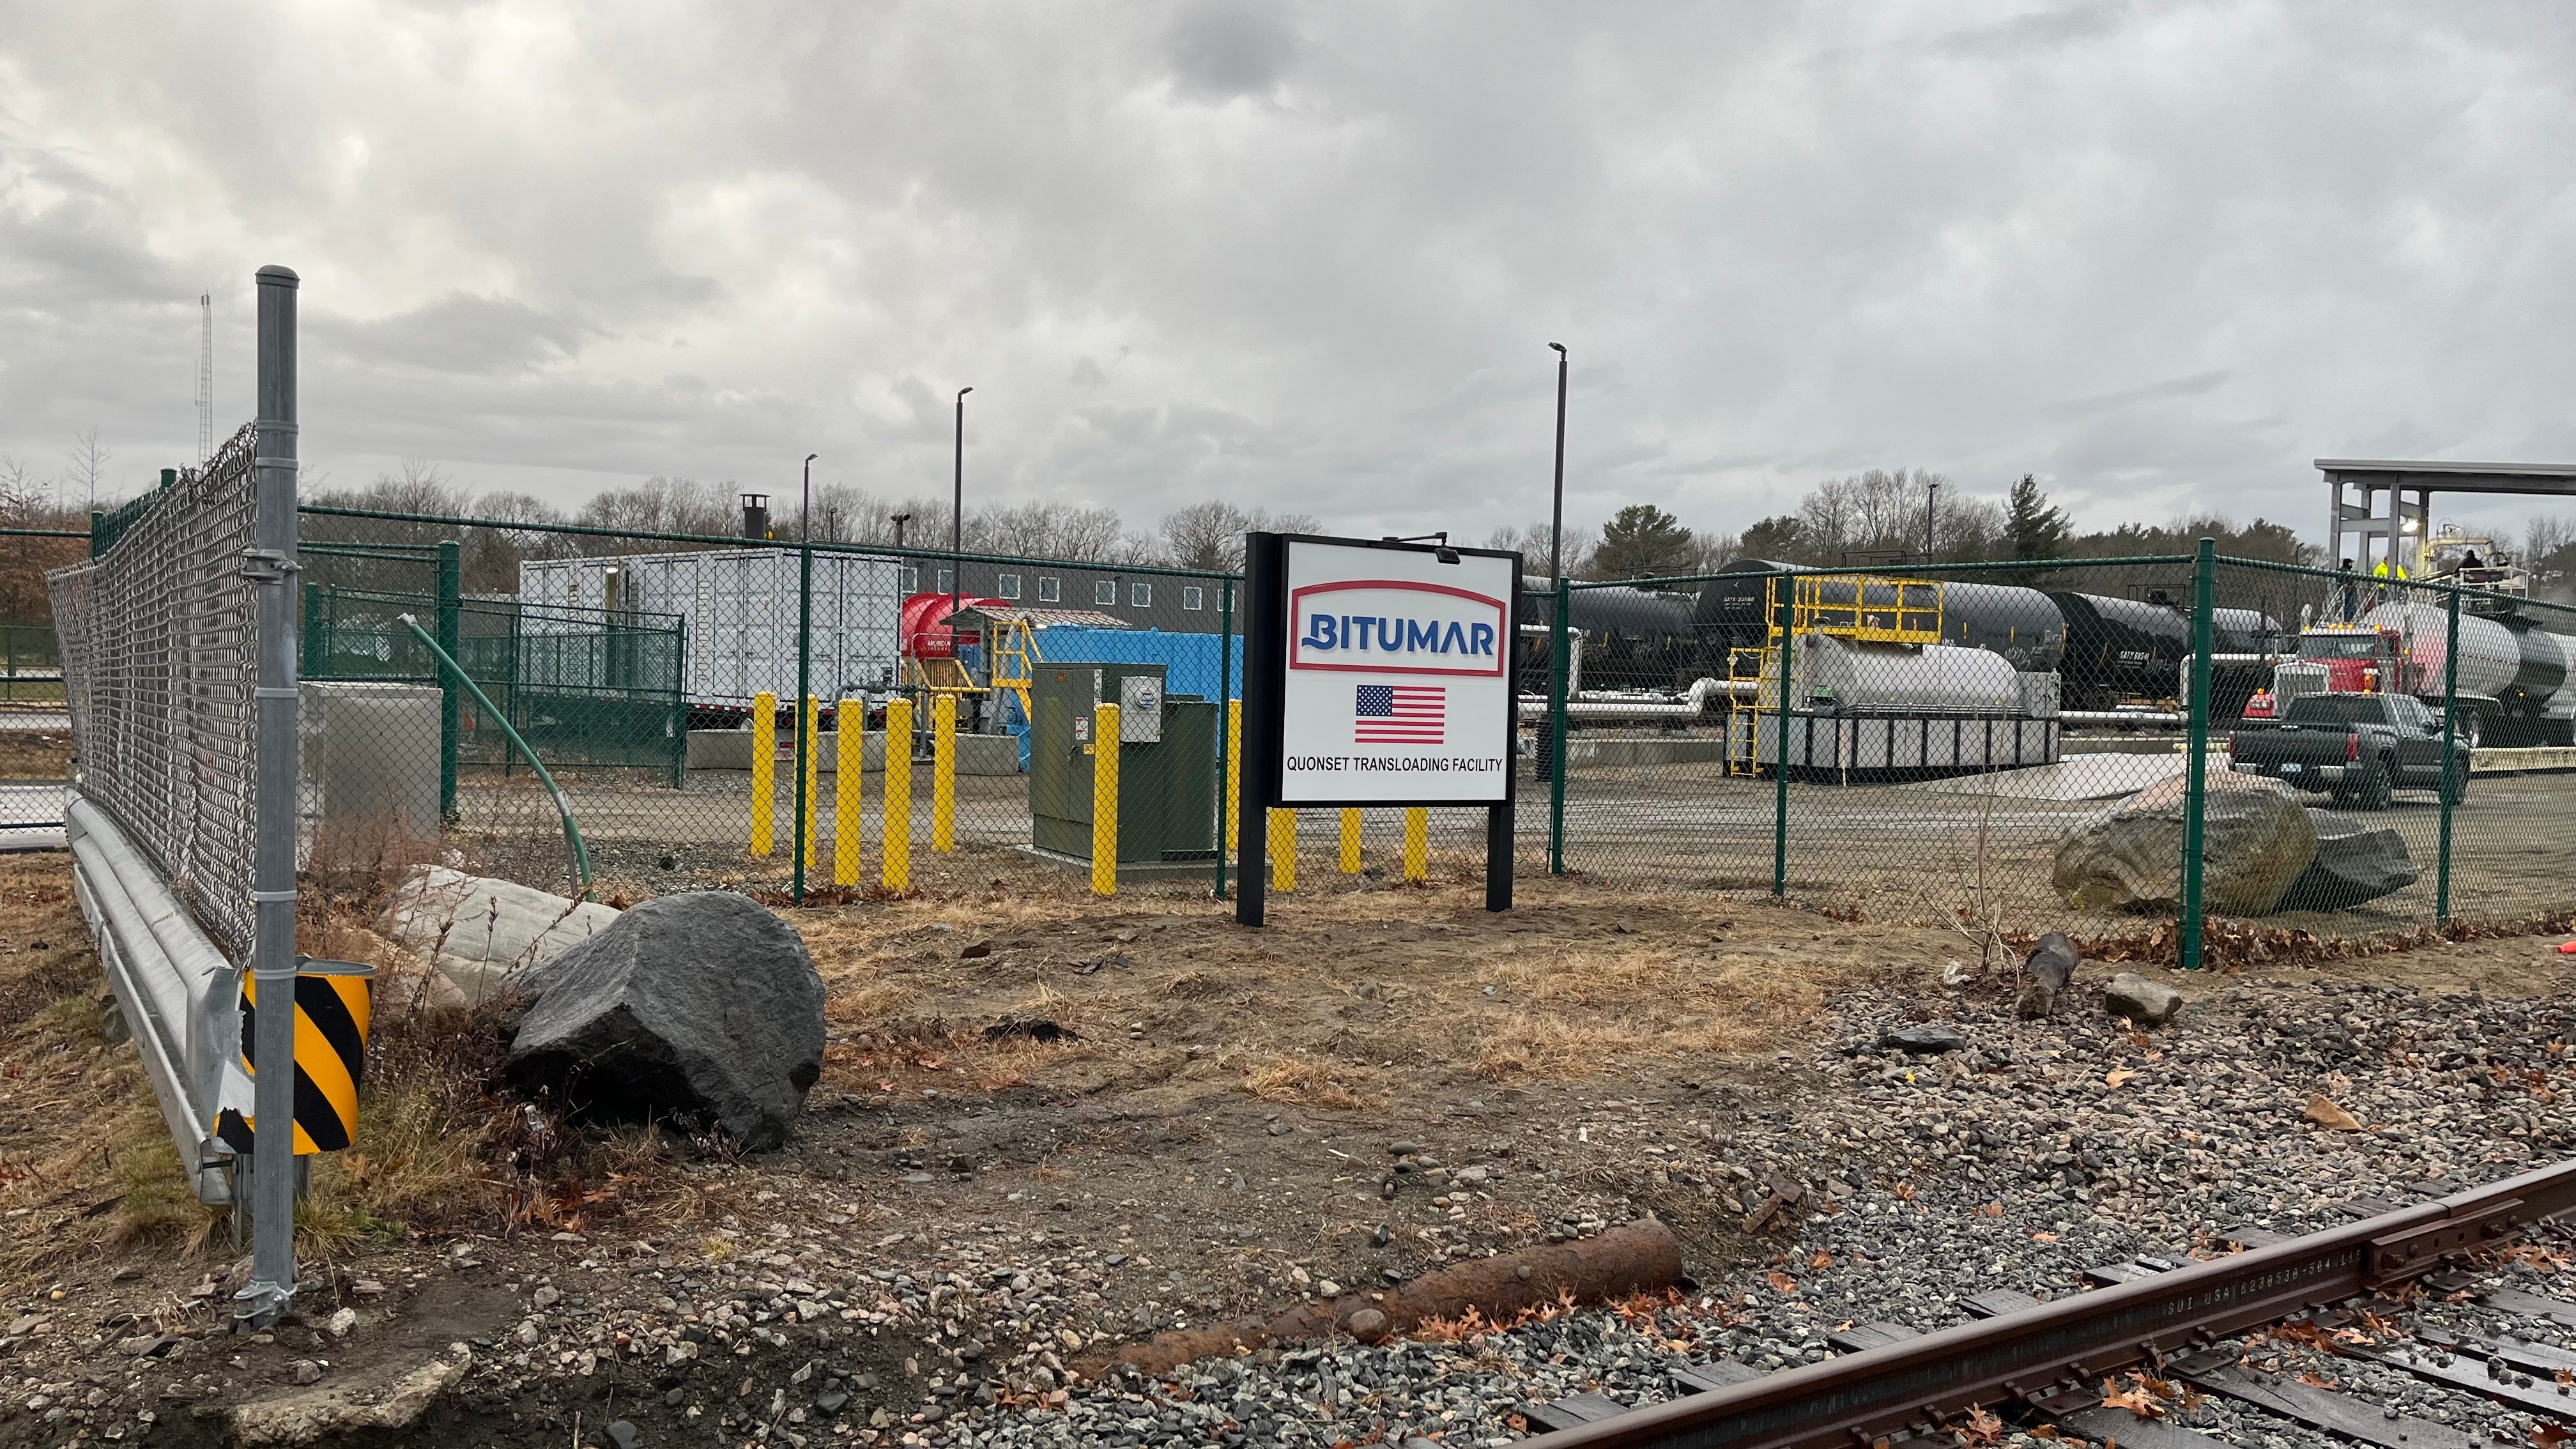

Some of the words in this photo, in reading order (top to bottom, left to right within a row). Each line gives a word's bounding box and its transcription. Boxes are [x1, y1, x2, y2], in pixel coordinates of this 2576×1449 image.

[1301, 613, 1494, 656] BITUMAR
[1287, 756, 1349, 771] QUONSET
[1353, 757, 1449, 771] TRANSLOADING
[1452, 758, 1503, 772] FACILITY
[2168, 1296, 2192, 1315] SDI
[2204, 1287, 2229, 1305] USA
